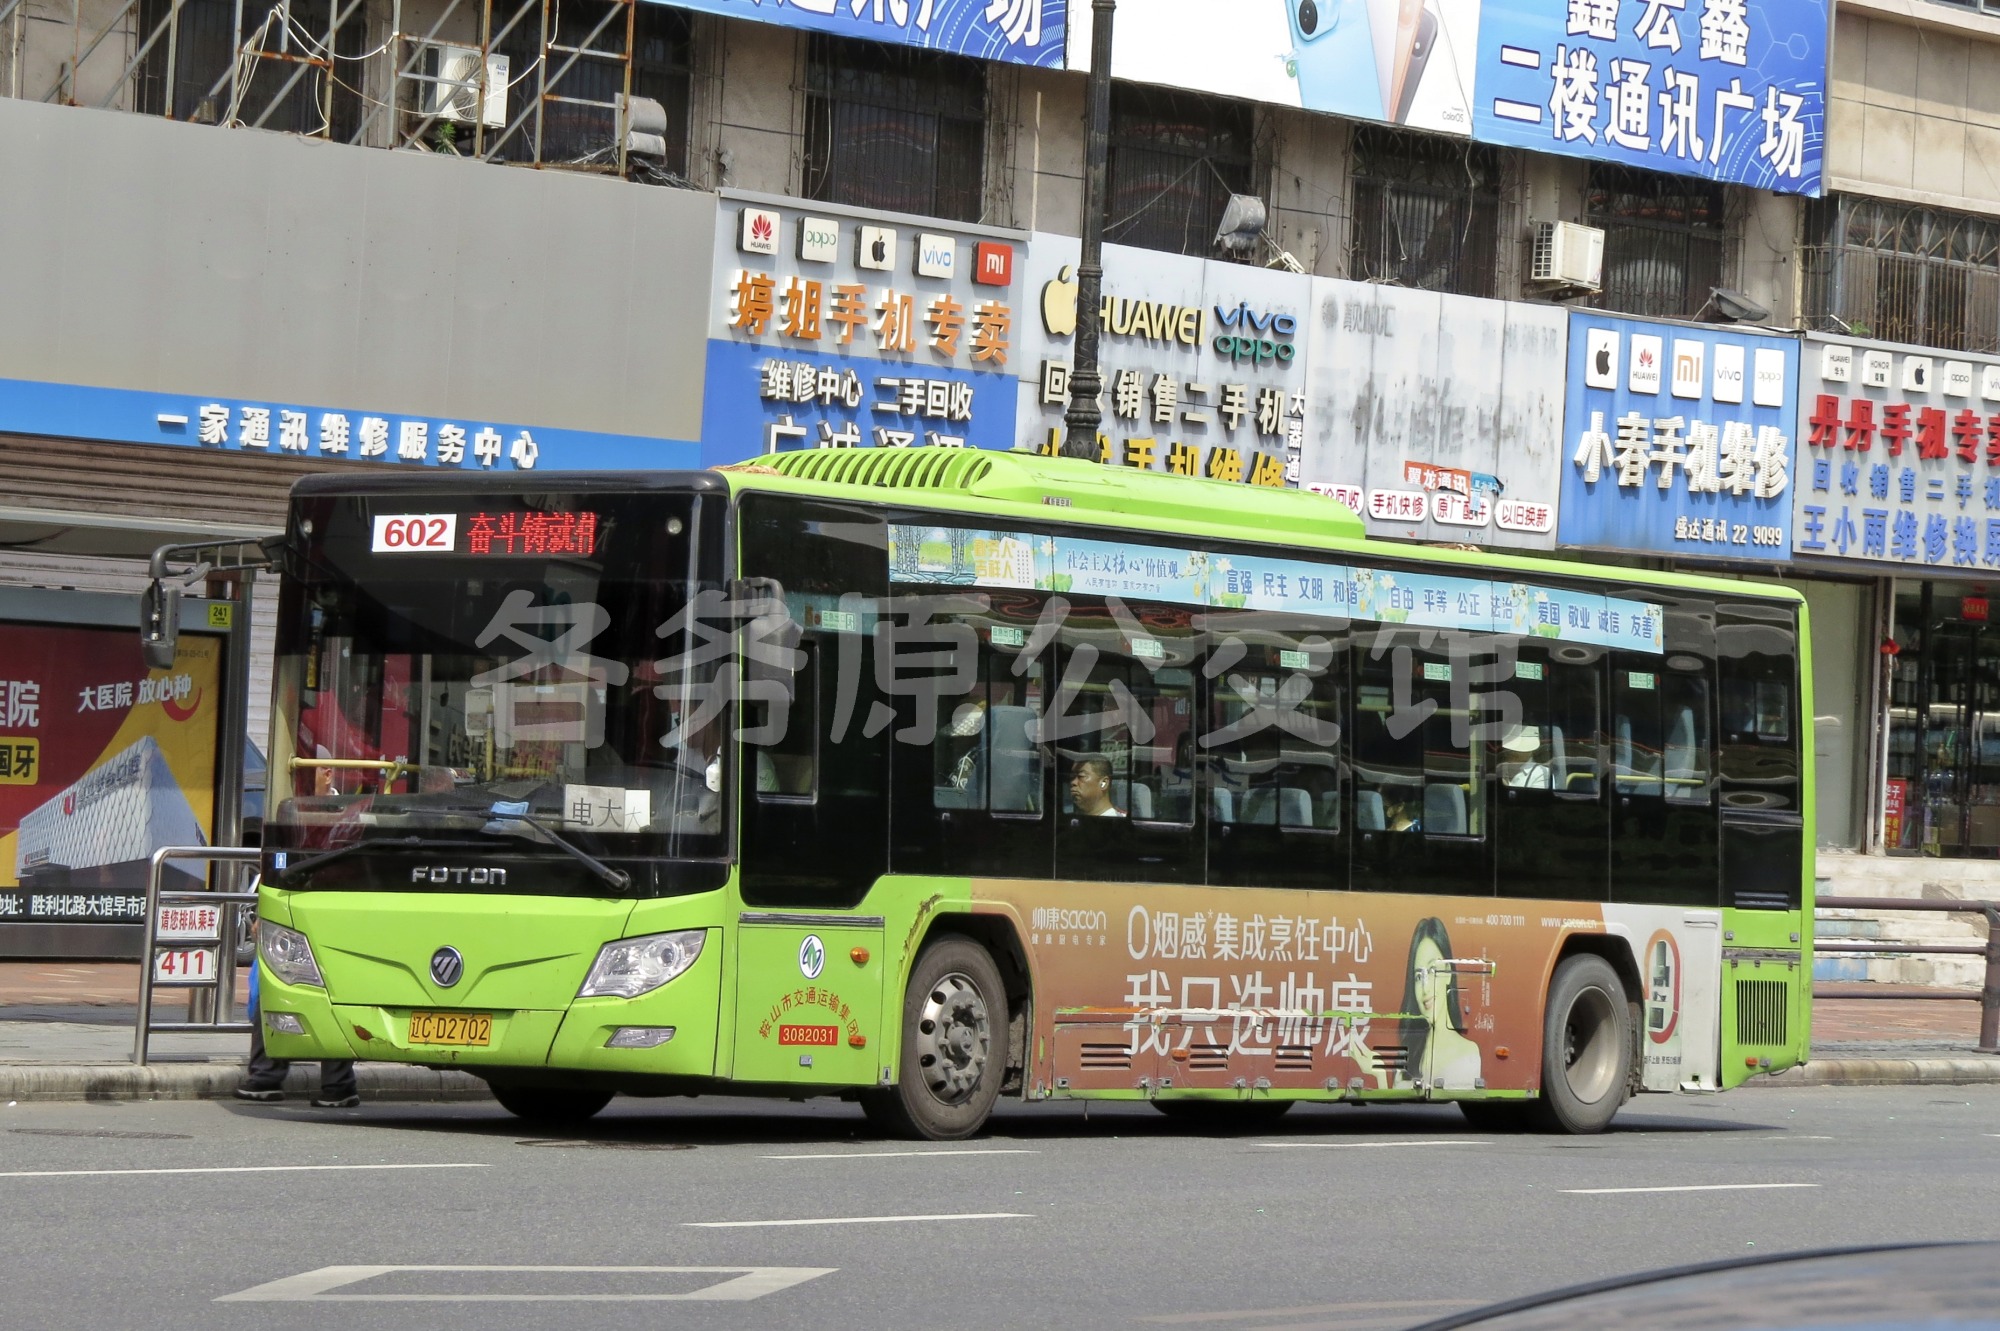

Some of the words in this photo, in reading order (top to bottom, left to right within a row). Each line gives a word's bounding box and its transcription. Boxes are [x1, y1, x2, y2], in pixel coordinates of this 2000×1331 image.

[1493, 43, 1806, 180] 二楼通讯广场
[750, 241, 771, 250] HUAWEI
[923, 246, 951, 267] vivo
[729, 269, 1011, 365] 婷姐手机专卖
[1100, 295, 1206, 346] HUAWEI
[1215, 301, 1298, 335] vivo
[762, 359, 863, 408] 维修中心
[873, 376, 974, 421] 二手回收
[1632, 370, 1658, 382] HUAWEI
[1716, 368, 1742, 382] vivo
[157, 403, 538, 469] 一家通讯维修服务中心
[1574, 411, 1789, 499] 小春手机维修
[1407, 466, 1469, 497] 翼龙通讯
[1373, 493, 1424, 517] 手机快修
[1501, 503, 1549, 528] 以旧换新
[384, 518, 448, 547] 602
[1674, 515, 1728, 542] 盛达通讯
[1732, 525, 1747, 544] 22
[1753, 526, 1783, 546] 9099
[1067, 550, 1179, 579] 社会主义核心价值观
[1226, 569, 1253, 595] 富强
[1264, 573, 1289, 598] 民主
[1298, 576, 1323, 601] 文明
[1333, 580, 1358, 605] 和谐
[213, 606, 227, 617] 241
[1390, 586, 1414, 610] 自由
[1423, 588, 1448, 614] 平等
[1457, 592, 1481, 617] 公正
[1490, 595, 1513, 620] 法治
[1538, 601, 1560, 626] 爱国
[1568, 605, 1590, 630] 敬业
[1598, 609, 1620, 634] 诚信
[1630, 614, 1653, 639] 友善
[78, 682, 133, 713] 大医院
[138, 673, 192, 704] 放心种
[573, 797, 622, 827] 电大
[411, 866, 507, 885] FOTON
[0, 893, 147, 917] 址：胜利北路大馆早市
[161, 909, 216, 931] 请您排队乘车
[1486, 914, 1498, 926] 400
[1500, 915, 1512, 926] 700
[1513, 916, 1525, 927] 1111
[161, 951, 205, 975] 411
[759, 986, 860, 1040] 鞍山市交通运输集团
[1123, 970, 1374, 1057] 我只选帅康
[783, 1027, 834, 1043] 3082031
